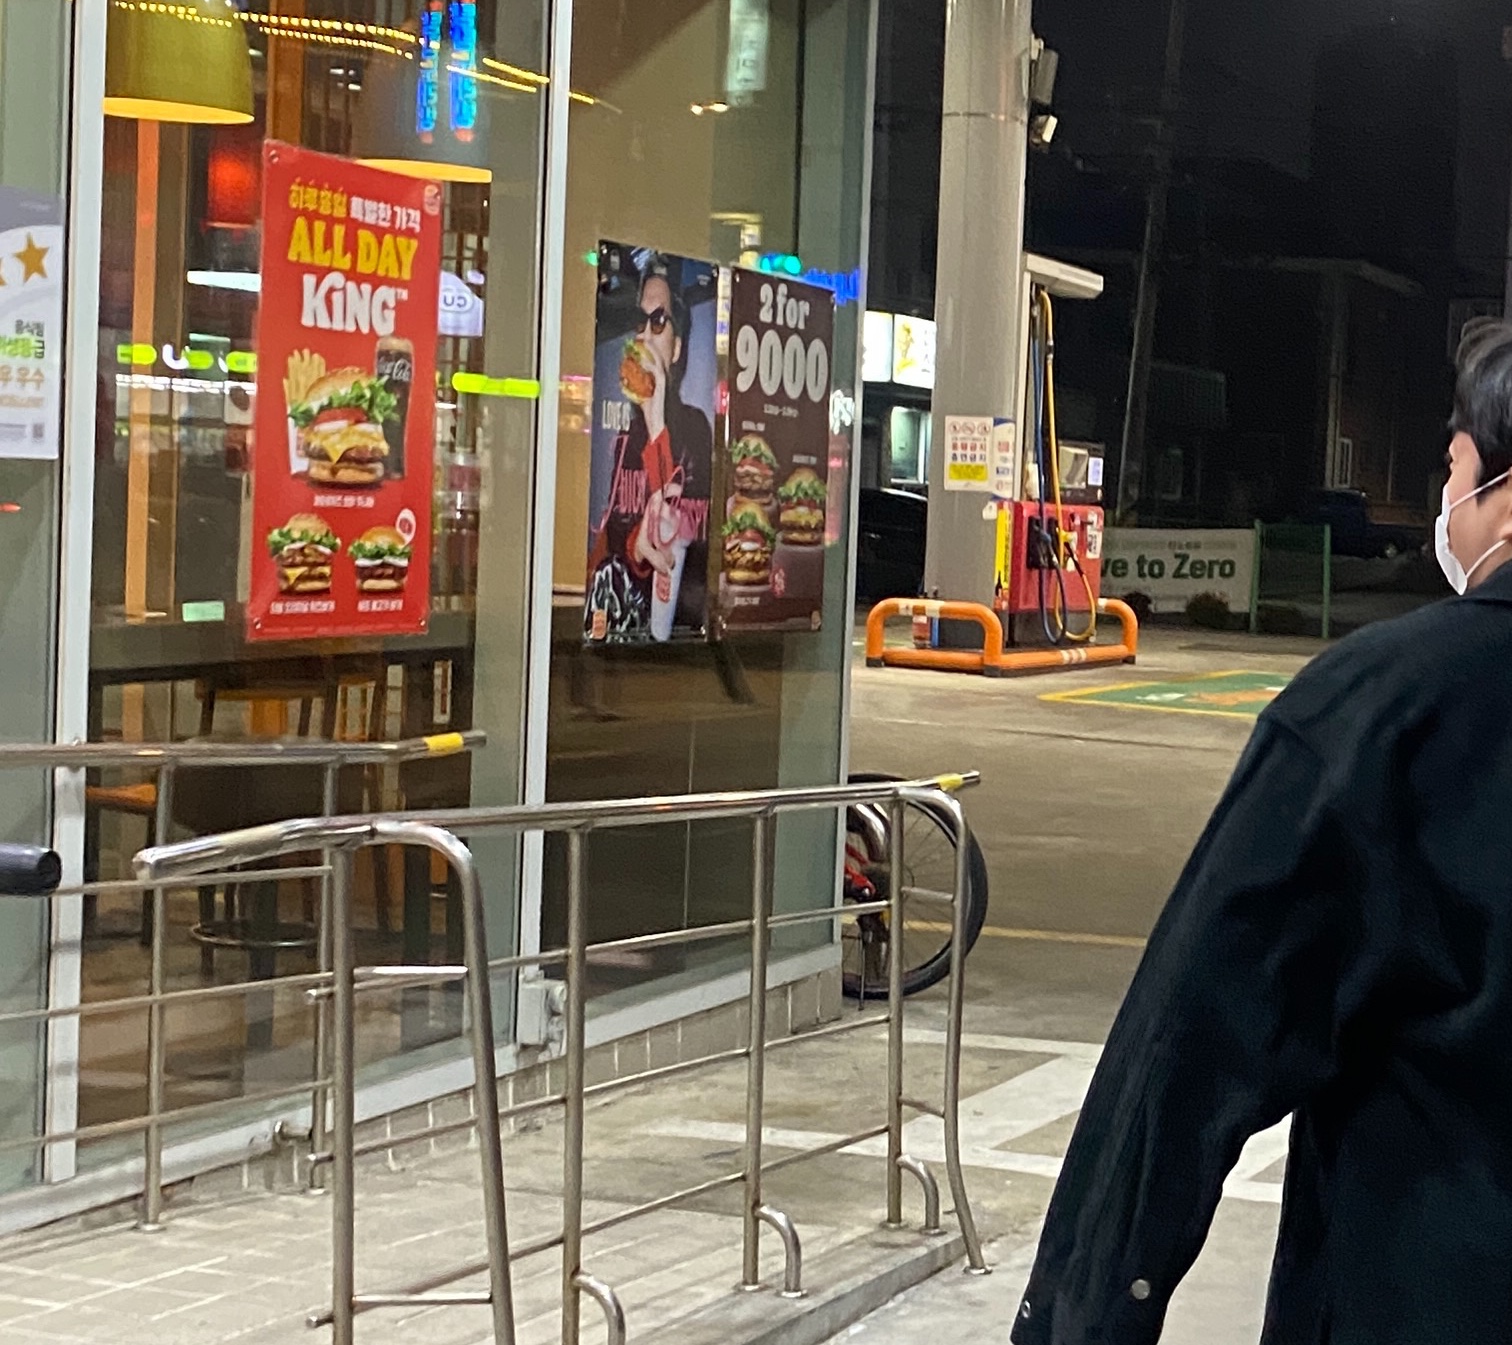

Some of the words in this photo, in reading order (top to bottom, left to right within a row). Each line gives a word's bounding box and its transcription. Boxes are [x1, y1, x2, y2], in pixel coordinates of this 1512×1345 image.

[393, 205, 421, 234] 가격
[287, 215, 351, 270] ALL
[356, 228, 418, 281] DAY
[759, 282, 774, 324] 2
[776, 282, 810, 330] for
[735, 324, 829, 404] 9000
[1136, 554, 1166, 580] to
[1172, 552, 1237, 580] Zero
